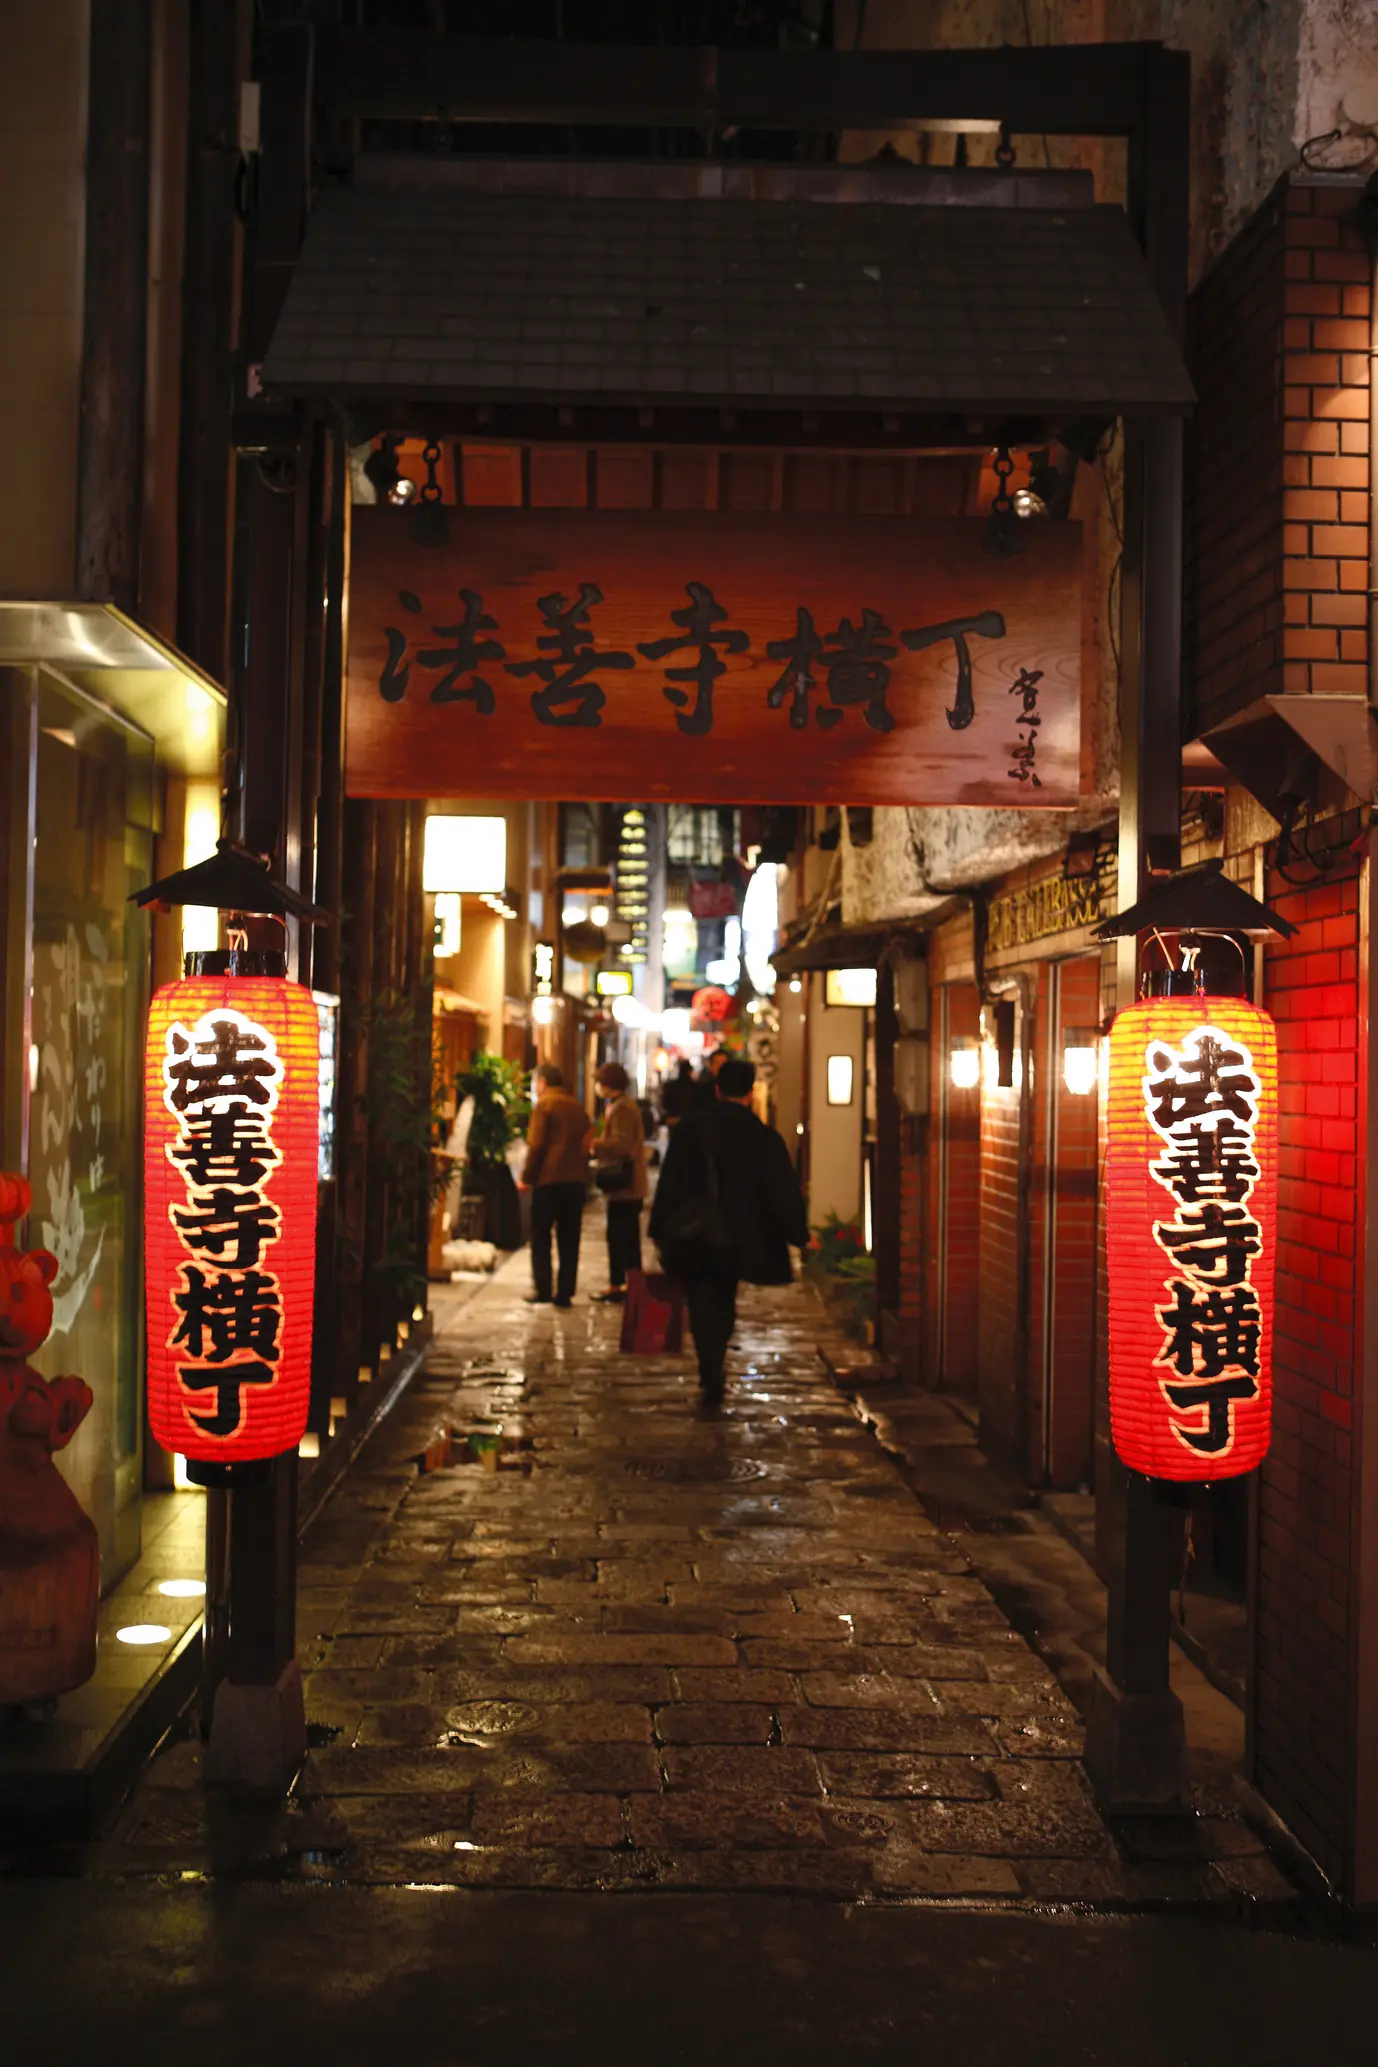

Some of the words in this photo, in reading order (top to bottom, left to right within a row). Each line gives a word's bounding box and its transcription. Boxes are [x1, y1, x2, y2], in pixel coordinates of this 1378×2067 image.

[380, 582, 1006, 735] 法善寺横丁
[168, 1019, 281, 1437] 法善寺横丁
[1147, 1034, 1260, 1453] 法善寺横丁
